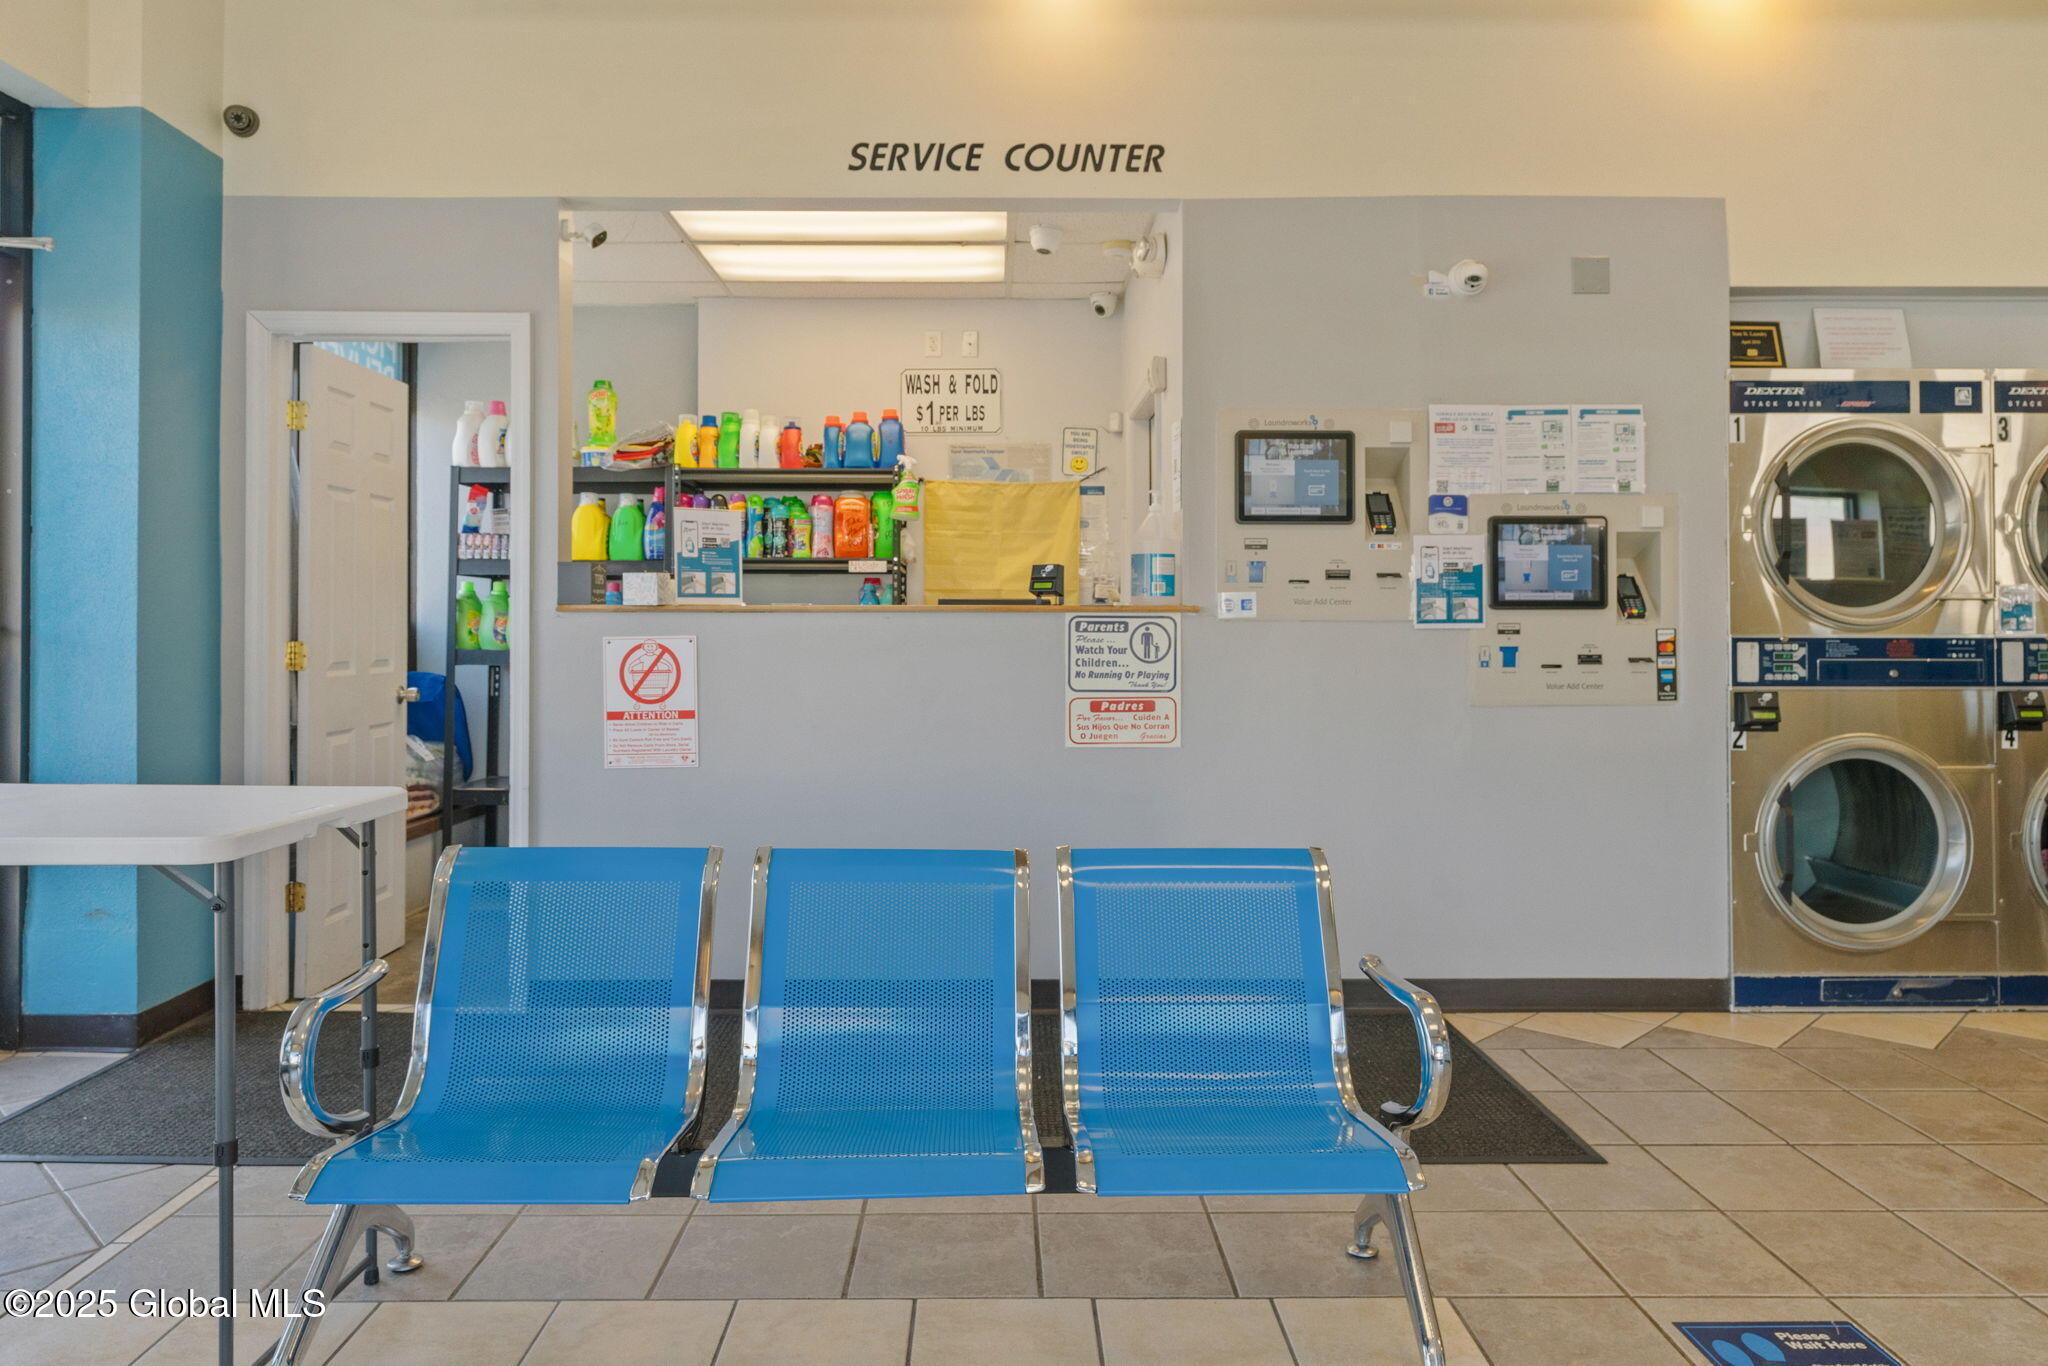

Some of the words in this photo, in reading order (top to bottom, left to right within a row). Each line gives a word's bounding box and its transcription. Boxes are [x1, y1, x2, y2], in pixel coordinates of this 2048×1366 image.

[848, 142, 984, 172] SERVICE
[1004, 143, 1166, 173] COUNTER
[905, 374, 940, 394] WASH
[948, 374, 957, 394] &
[965, 374, 998, 394] FOLD
[1744, 387, 1805, 396] DEXTER
[2008, 386, 2048, 396] DEXT
[939, 405, 959, 421] PER
[965, 405, 986, 422] LBS
[1264, 418, 1312, 426] Laundroworks
[1733, 416, 1740, 442] 1
[1998, 416, 2008, 442] 3
[1516, 503, 1564, 512] Laundroworks
[1314, 598, 1328, 606] Add
[1329, 598, 1352, 606] Center
[1079, 622, 1125, 632] Parents
[1075, 645, 1104, 655] Watch
[1107, 645, 1128, 655] Your
[1075, 658, 1129, 667] Children...
[1075, 671, 1086, 679] No
[1088, 671, 1122, 680] Running
[1125, 671, 1134, 679] Or
[1137, 671, 1170, 680] Playing
[1100, 702, 1144, 711] Padres
[623, 711, 679, 720] ATTENTION
[1092, 723, 1111, 731] Hijos
[1113, 723, 1128, 731] Que
[1733, 730, 1744, 748] 2
[2005, 729, 2015, 747] 4
[1774, 1332, 1831, 1341] Please
[1784, 1341, 1826, 1350] Wait
[1825, 1341, 1868, 1350] Here
